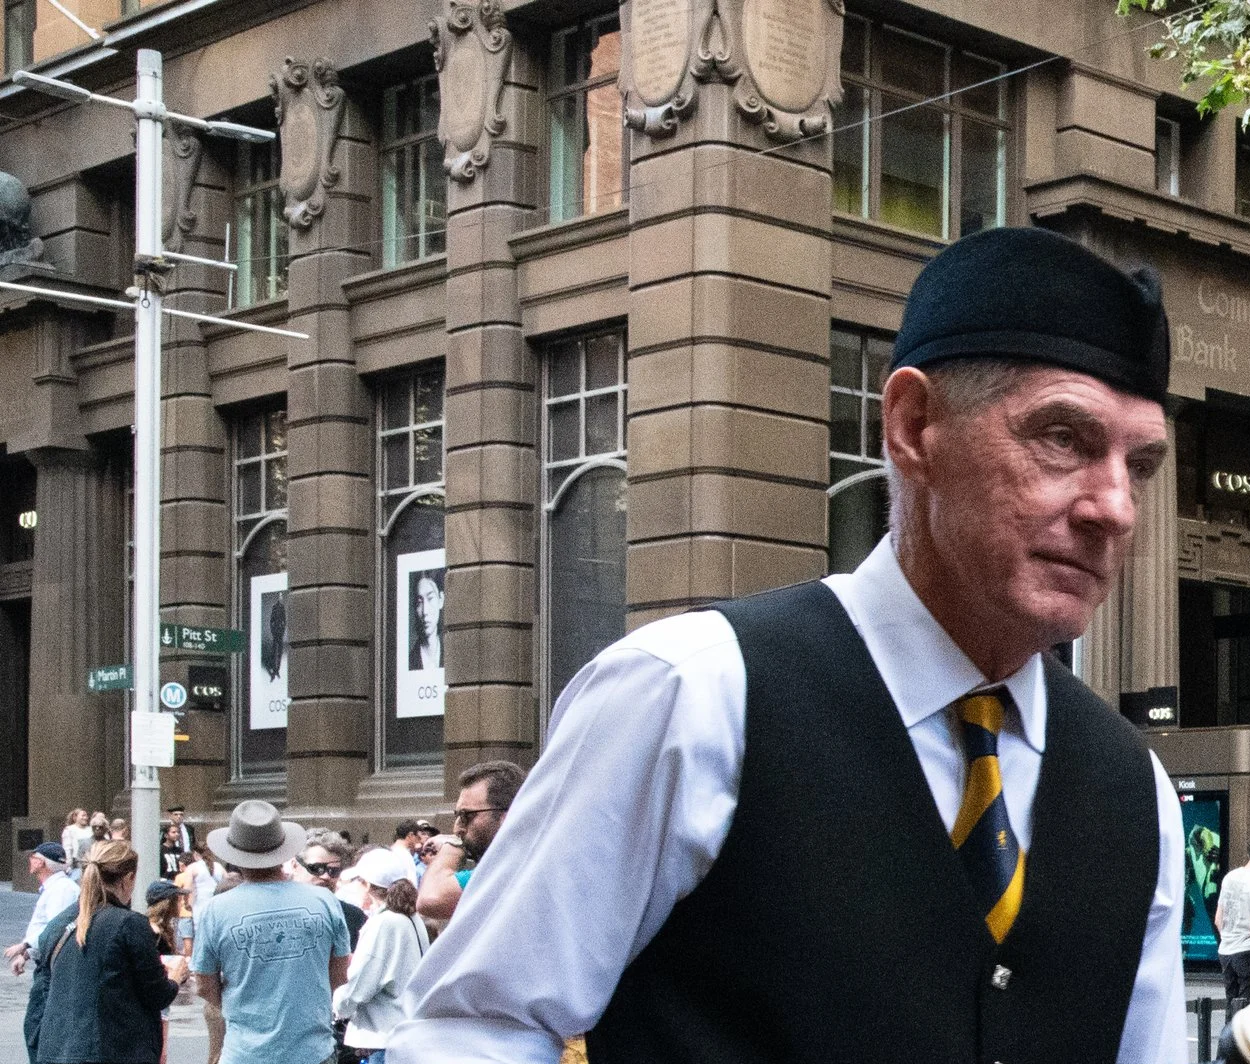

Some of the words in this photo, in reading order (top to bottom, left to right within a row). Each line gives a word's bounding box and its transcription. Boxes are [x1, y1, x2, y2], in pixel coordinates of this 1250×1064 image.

[1173, 323, 1237, 373] Bank
[182, 627, 202, 640] Pitt
[205, 629, 217, 643] St
[97, 669, 119, 681] Martin
[193, 685, 222, 697] COS
[418, 685, 438, 700] COS
[269, 700, 287, 713] COS
[1178, 780, 1196, 789] Kiosk
[237, 924, 262, 944] SUN
[268, 916, 319, 932] VALLEY
